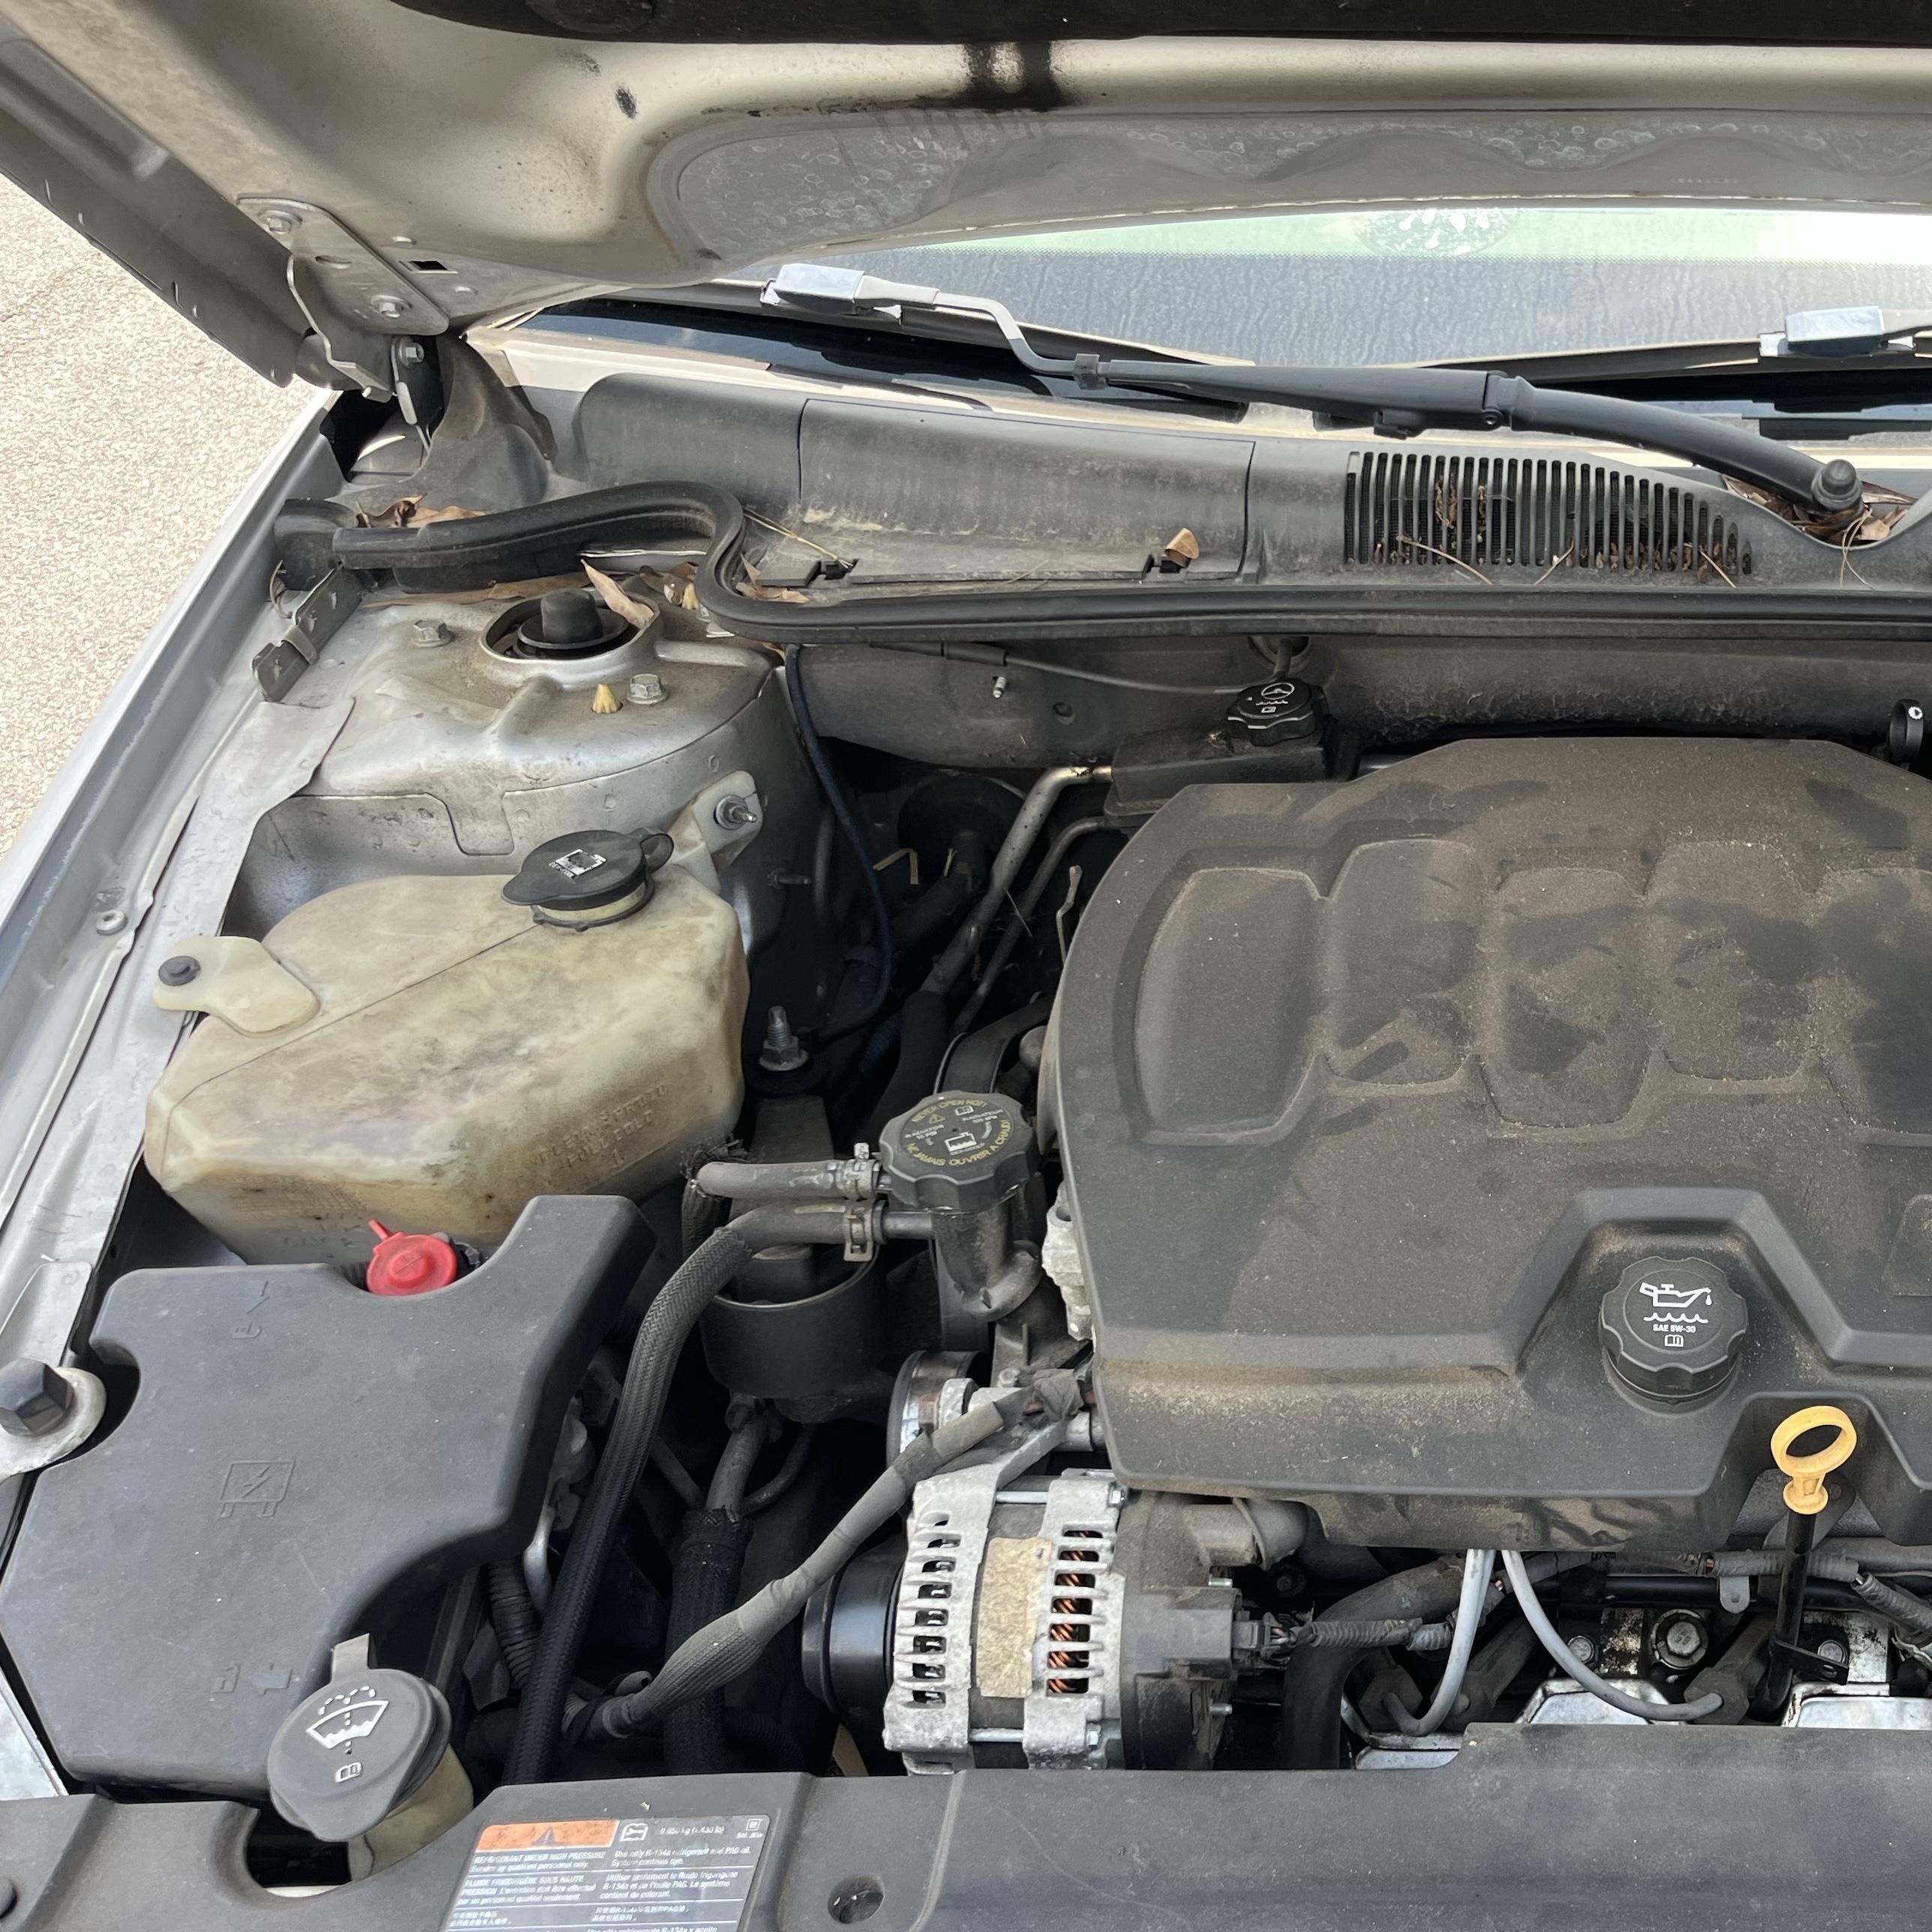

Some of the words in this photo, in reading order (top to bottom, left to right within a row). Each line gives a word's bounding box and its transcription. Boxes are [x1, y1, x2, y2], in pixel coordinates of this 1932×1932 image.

[911, 1106, 938, 1122] NEVER
[938, 1100, 964, 1108] OPEN
[914, 1152, 946, 1166] JAMAIS
[949, 1150, 992, 1166] OUVRIR
[1652, 1323, 1669, 1332] SAE
[1670, 1324, 1696, 1334] 5W-30
[549, 1852, 568, 1861] HIGH
[568, 1851, 607, 1860] PRESSURE
[536, 1862, 573, 1871] personnel
[538, 1876, 559, 1884] SOUS
[559, 1875, 585, 1883] HAUTE
[603, 1882, 628, 1890] R-134a
[688, 1880, 700, 1888] Le
[640, 1889, 671, 1899] colorant.
